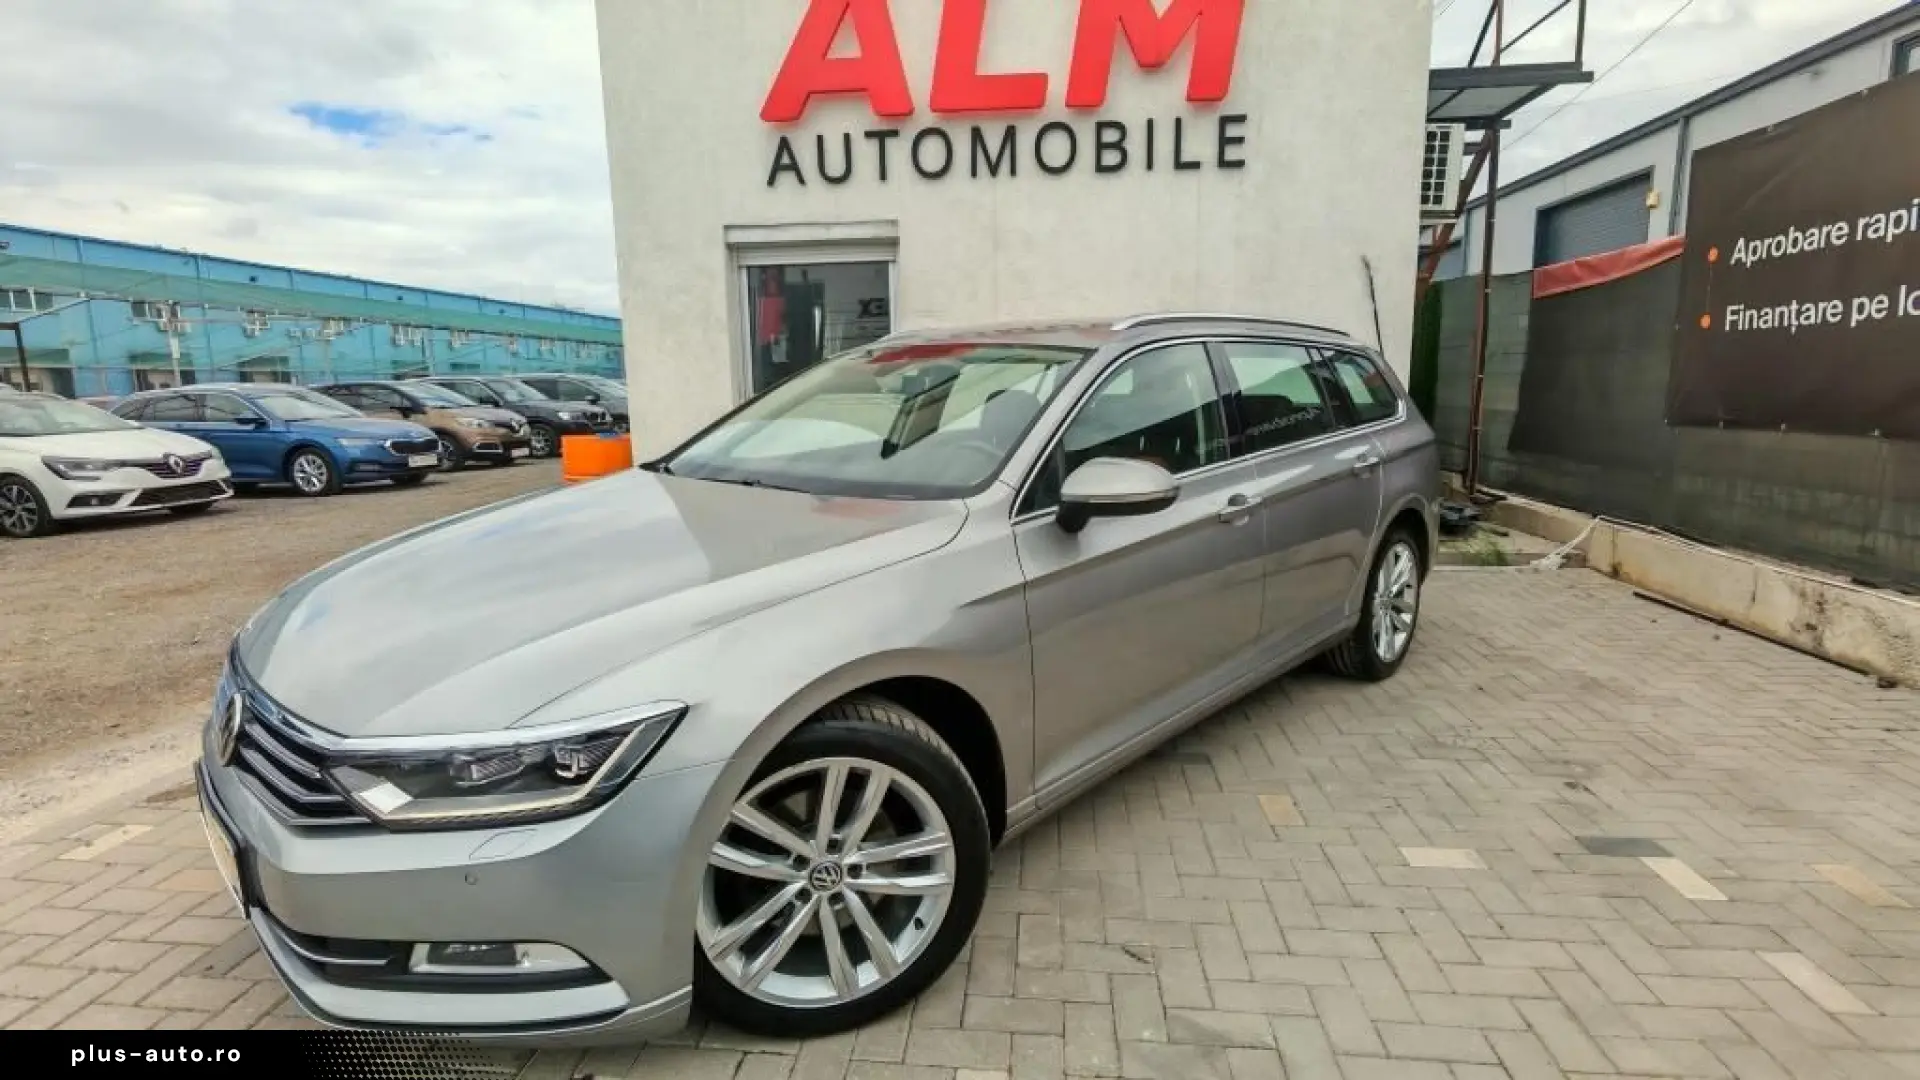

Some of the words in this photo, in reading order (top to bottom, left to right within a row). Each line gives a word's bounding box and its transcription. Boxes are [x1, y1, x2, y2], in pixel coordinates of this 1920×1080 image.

[759, 0, 1246, 122] ALM
[766, 113, 1248, 187] AUTOMOBILE
[1729, 220, 1850, 268] Aprobare
[1724, 299, 1844, 335] Finanțare
[1850, 293, 1889, 329] pe
